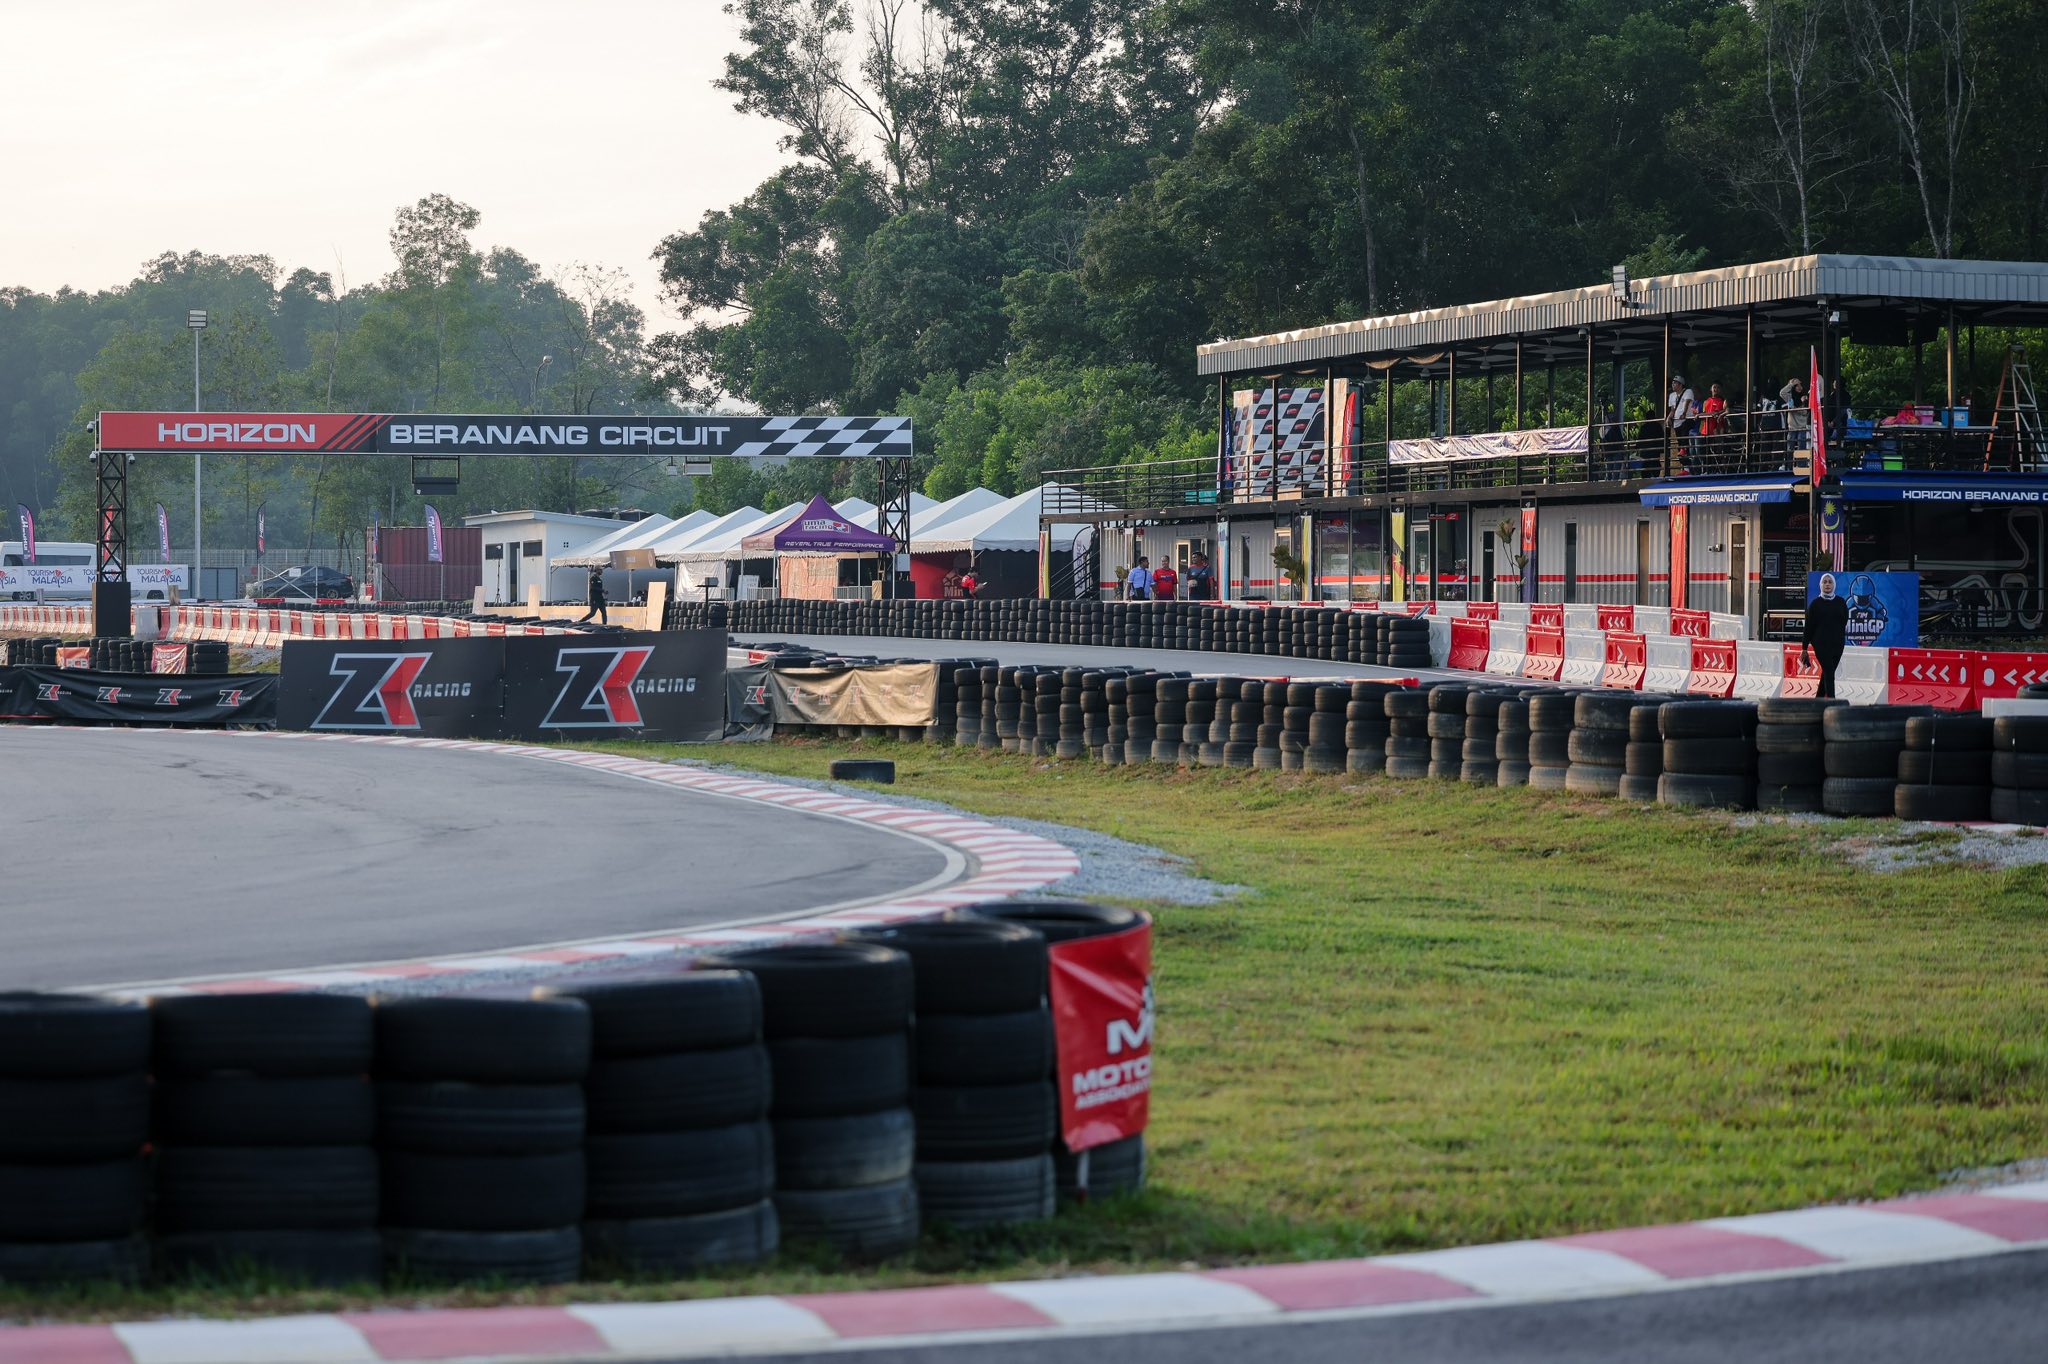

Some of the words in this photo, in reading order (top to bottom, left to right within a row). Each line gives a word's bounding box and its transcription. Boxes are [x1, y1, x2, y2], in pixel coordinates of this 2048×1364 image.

[158, 423, 316, 443] HORIZON
[390, 424, 589, 445] BERANANG
[600, 426, 731, 446] CIRCUIT
[1669, 495, 1697, 504] HORIZON
[1697, 493, 1733, 503] BERANANG
[1902, 490, 1962, 500] HORIZON
[1964, 491, 2039, 501] BERANANG
[32, 575, 73, 588] MALAYSIA
[141, 574, 182, 585] MALAYSIA
[413, 682, 472, 698] RACING
[635, 677, 697, 694] RACING
